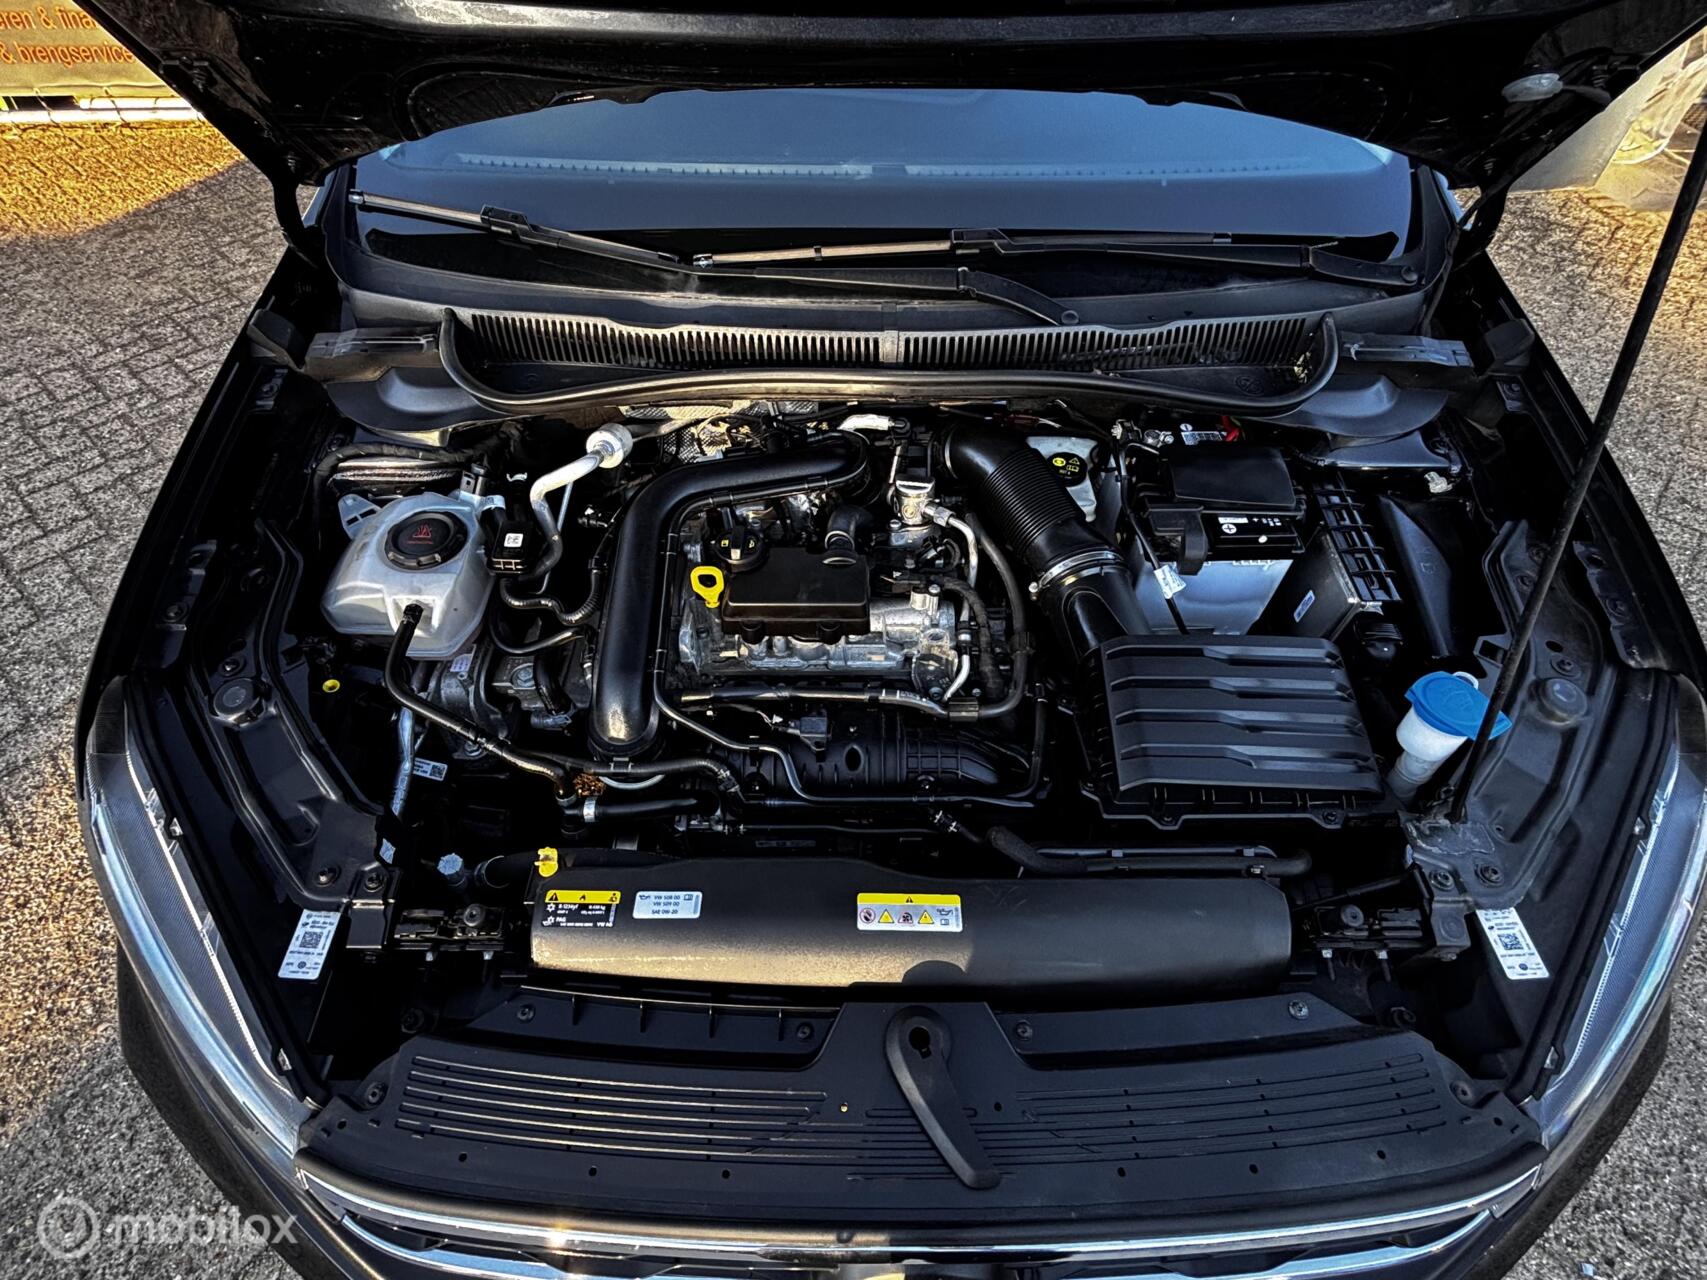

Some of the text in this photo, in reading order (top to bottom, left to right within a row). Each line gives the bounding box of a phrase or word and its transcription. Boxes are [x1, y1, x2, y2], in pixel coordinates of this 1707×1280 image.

[37, 6, 57, 29] &
[0, 40, 135, 68] & brengservice
